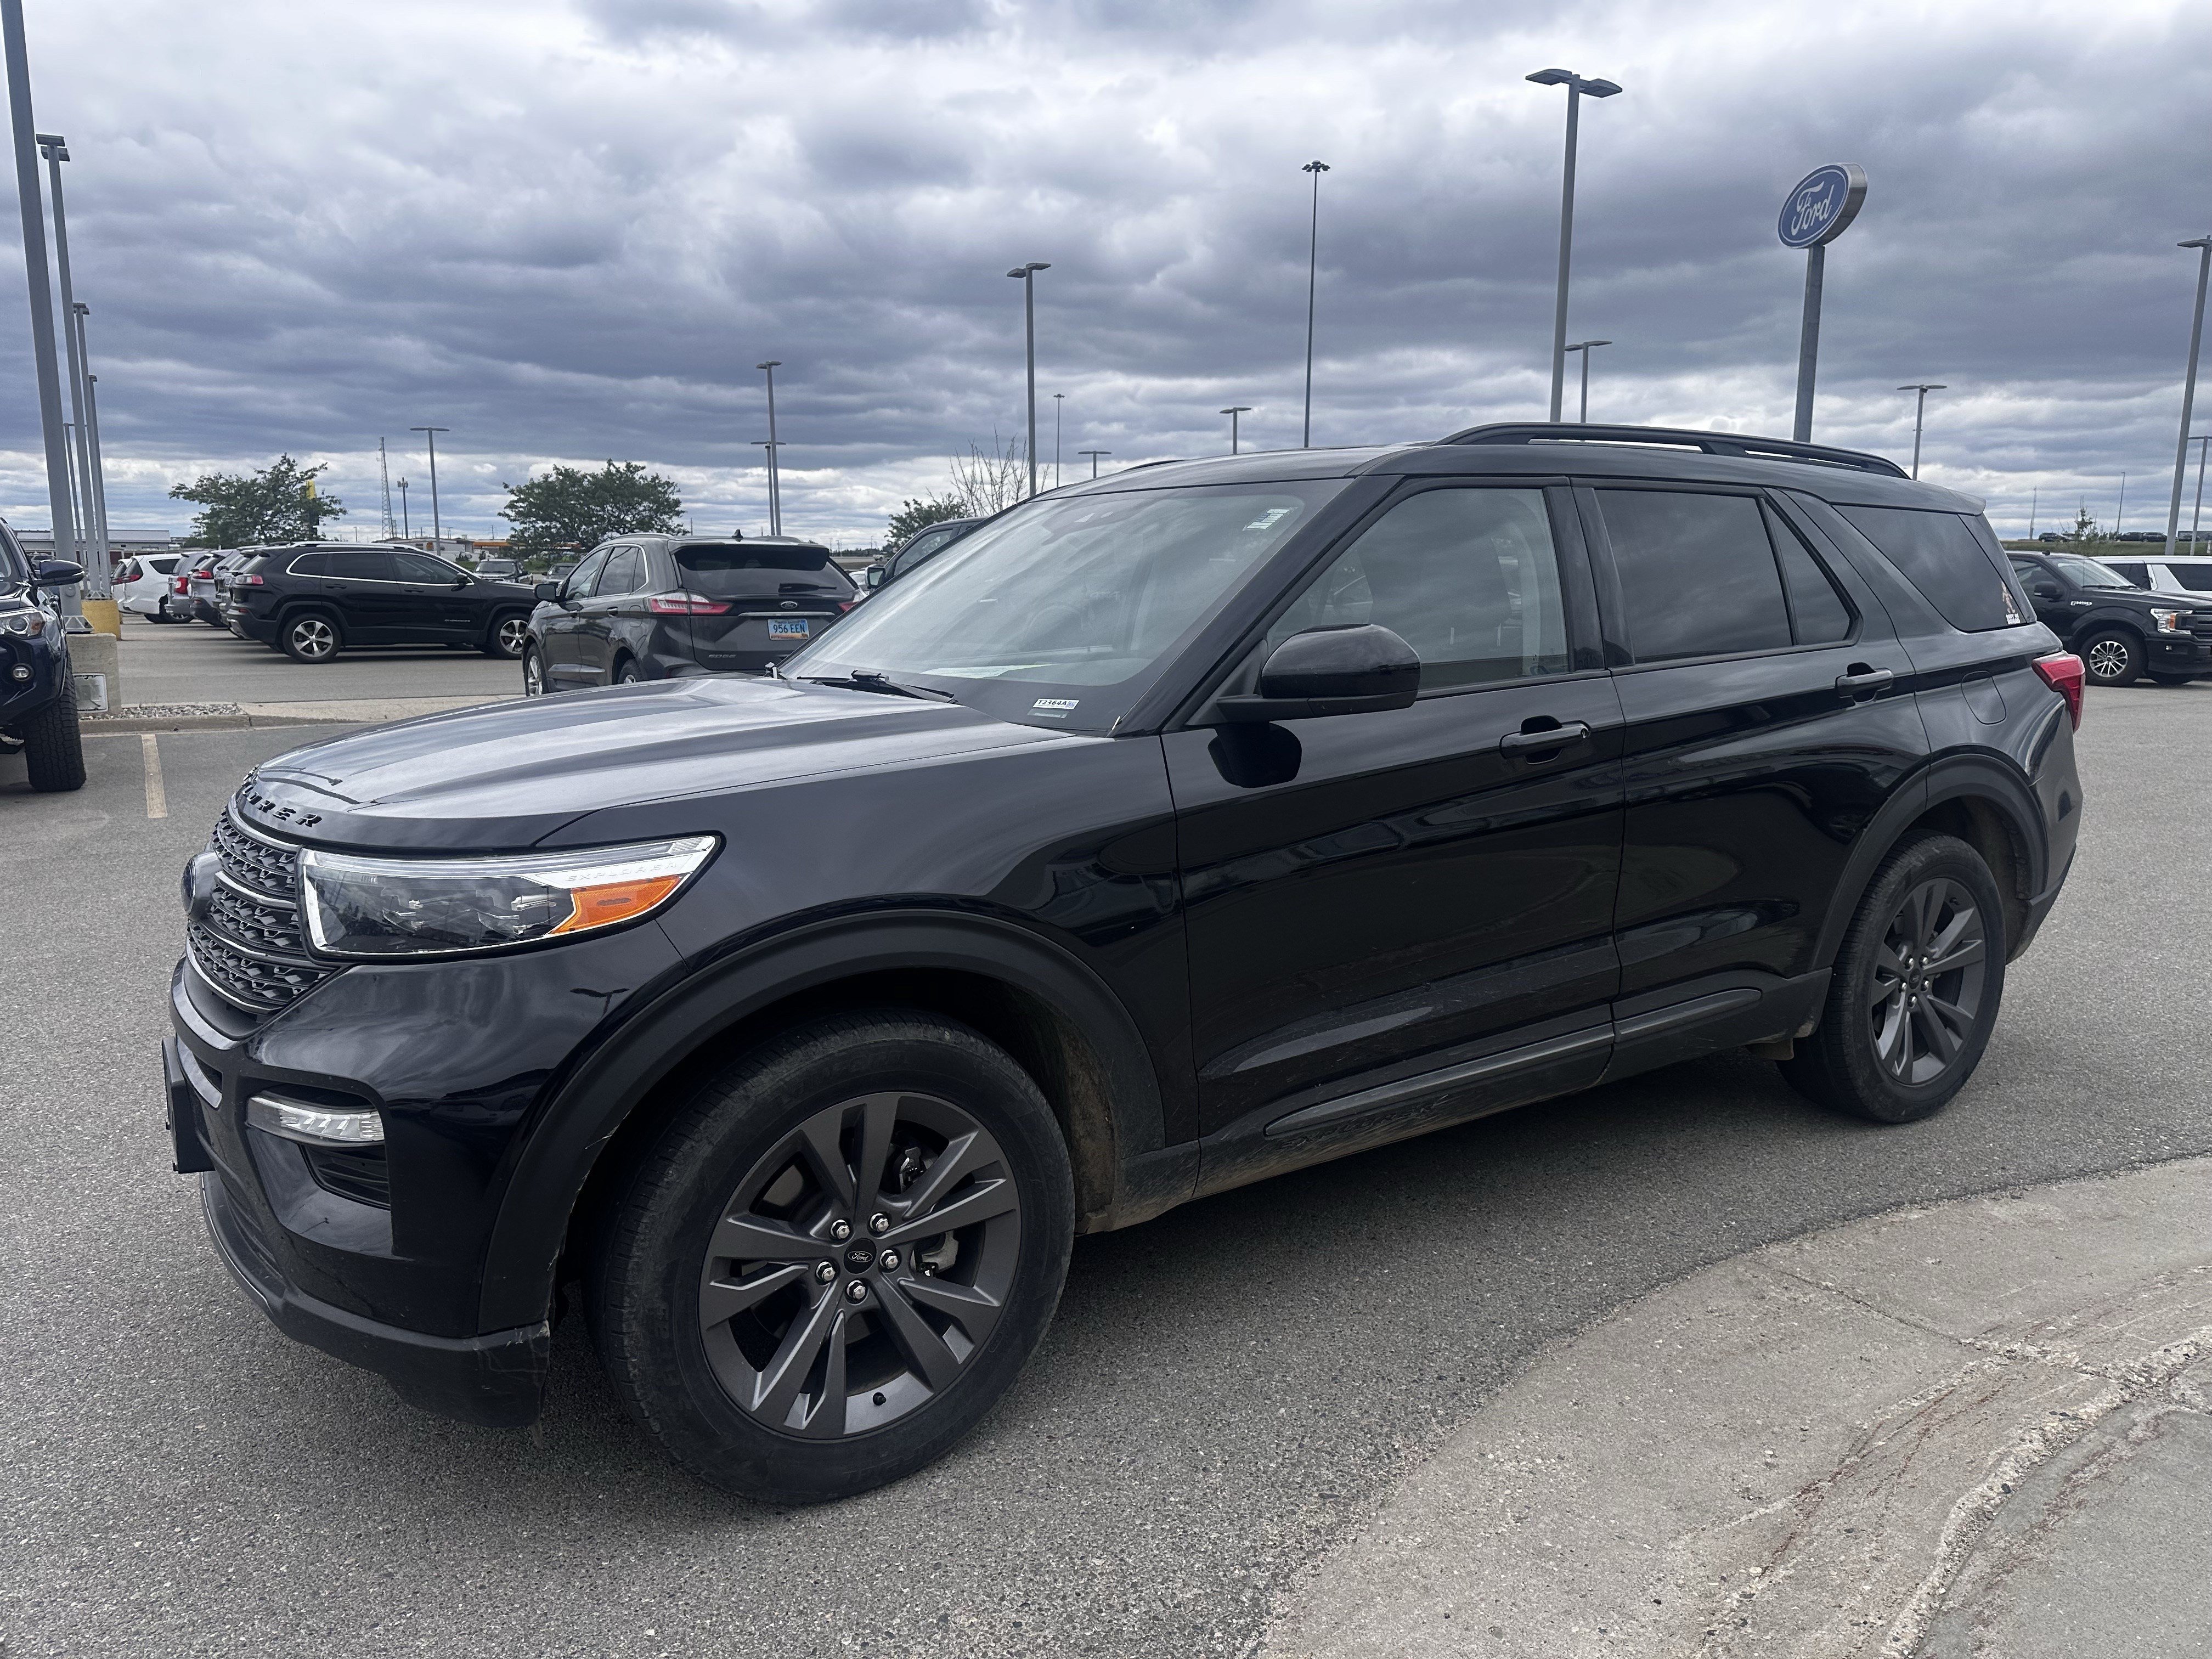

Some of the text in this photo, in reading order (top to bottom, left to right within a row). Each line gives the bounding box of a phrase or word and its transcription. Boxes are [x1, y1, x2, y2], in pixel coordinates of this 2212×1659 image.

[1791, 181, 1835, 236] Ford
[773, 624, 805, 633] 956 EEN
[565, 862, 677, 882] EXPLORER
[851, 1252, 870, 1262] Ford
